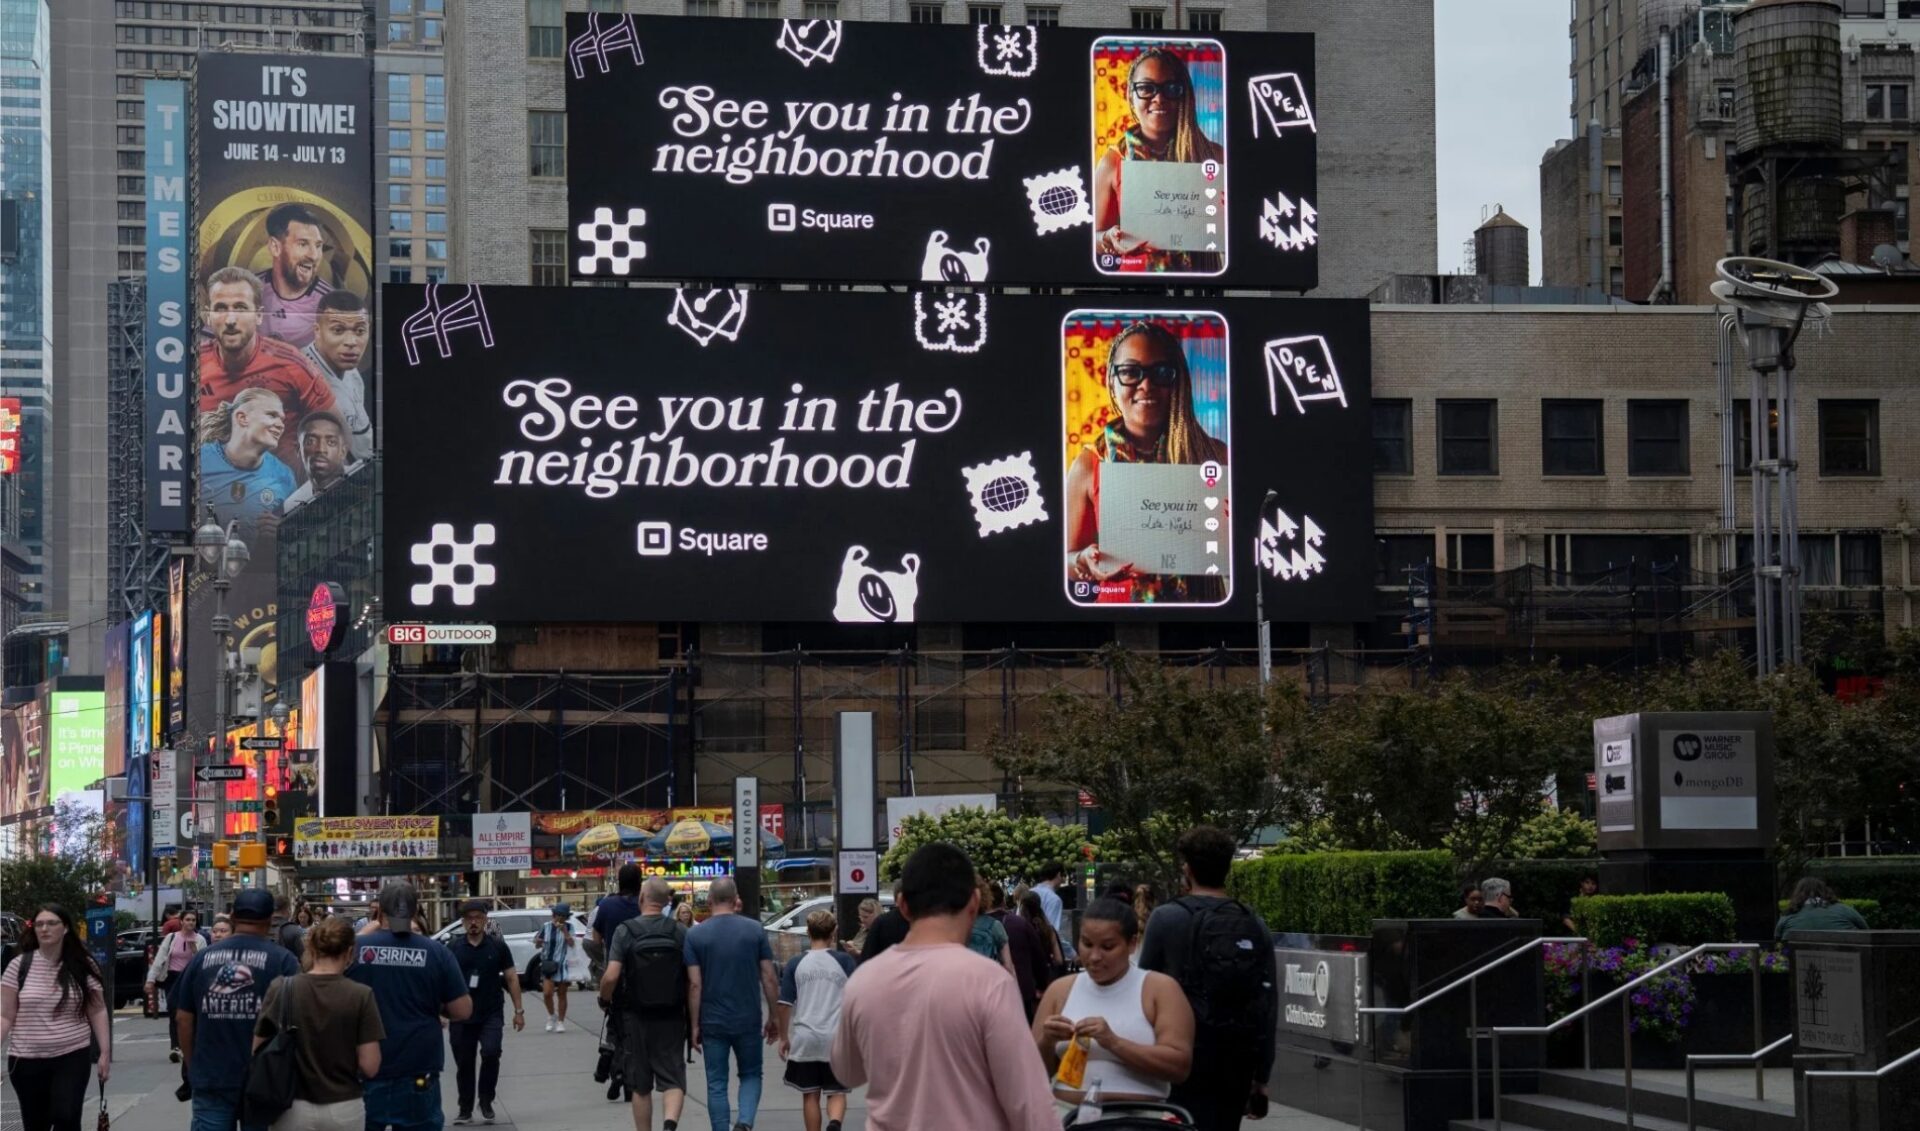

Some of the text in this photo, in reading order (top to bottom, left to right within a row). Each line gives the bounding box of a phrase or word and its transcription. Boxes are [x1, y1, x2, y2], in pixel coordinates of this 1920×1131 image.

[262, 66, 307, 97] IT'S
[1260, 82, 1306, 119] OPEN
[213, 99, 356, 135] SHOWTIME!
[659, 85, 1031, 139] See you in the
[224, 143, 259, 161] JUNE
[262, 144, 278, 161] 14
[293, 146, 326, 163] JULY
[330, 147, 346, 164] 13
[652, 134, 994, 184] neighborhood
[1154, 190, 1200, 202] See you in
[802, 209, 874, 232] Square
[154, 105, 184, 506] TIMES SQUARE
[1279, 346, 1334, 392] OPEN
[503, 378, 963, 441] See you in the
[493, 437, 917, 498] neighborhood
[1140, 499, 1198, 513] See you in
[679, 527, 768, 556] Square
[1092, 584, 1126, 595] @square
[394, 628, 492, 641] BIG OUTDOOR
[1703, 735, 1742, 743] WARNER
[1704, 743, 1733, 751] MUSIC
[1704, 751, 1737, 760] GROUP
[1686, 776, 1744, 791] mongoDB
[743, 789, 752, 855] EQUINOX
[478, 832, 526, 842] ALL EMPIRE
[95, 920, 105, 935] P
[202, 949, 268, 970] UNION LABOR
[378, 948, 424, 962] SIRINA
[1284, 963, 1316, 997] Allianz
[201, 994, 262, 1014] AMERICA
